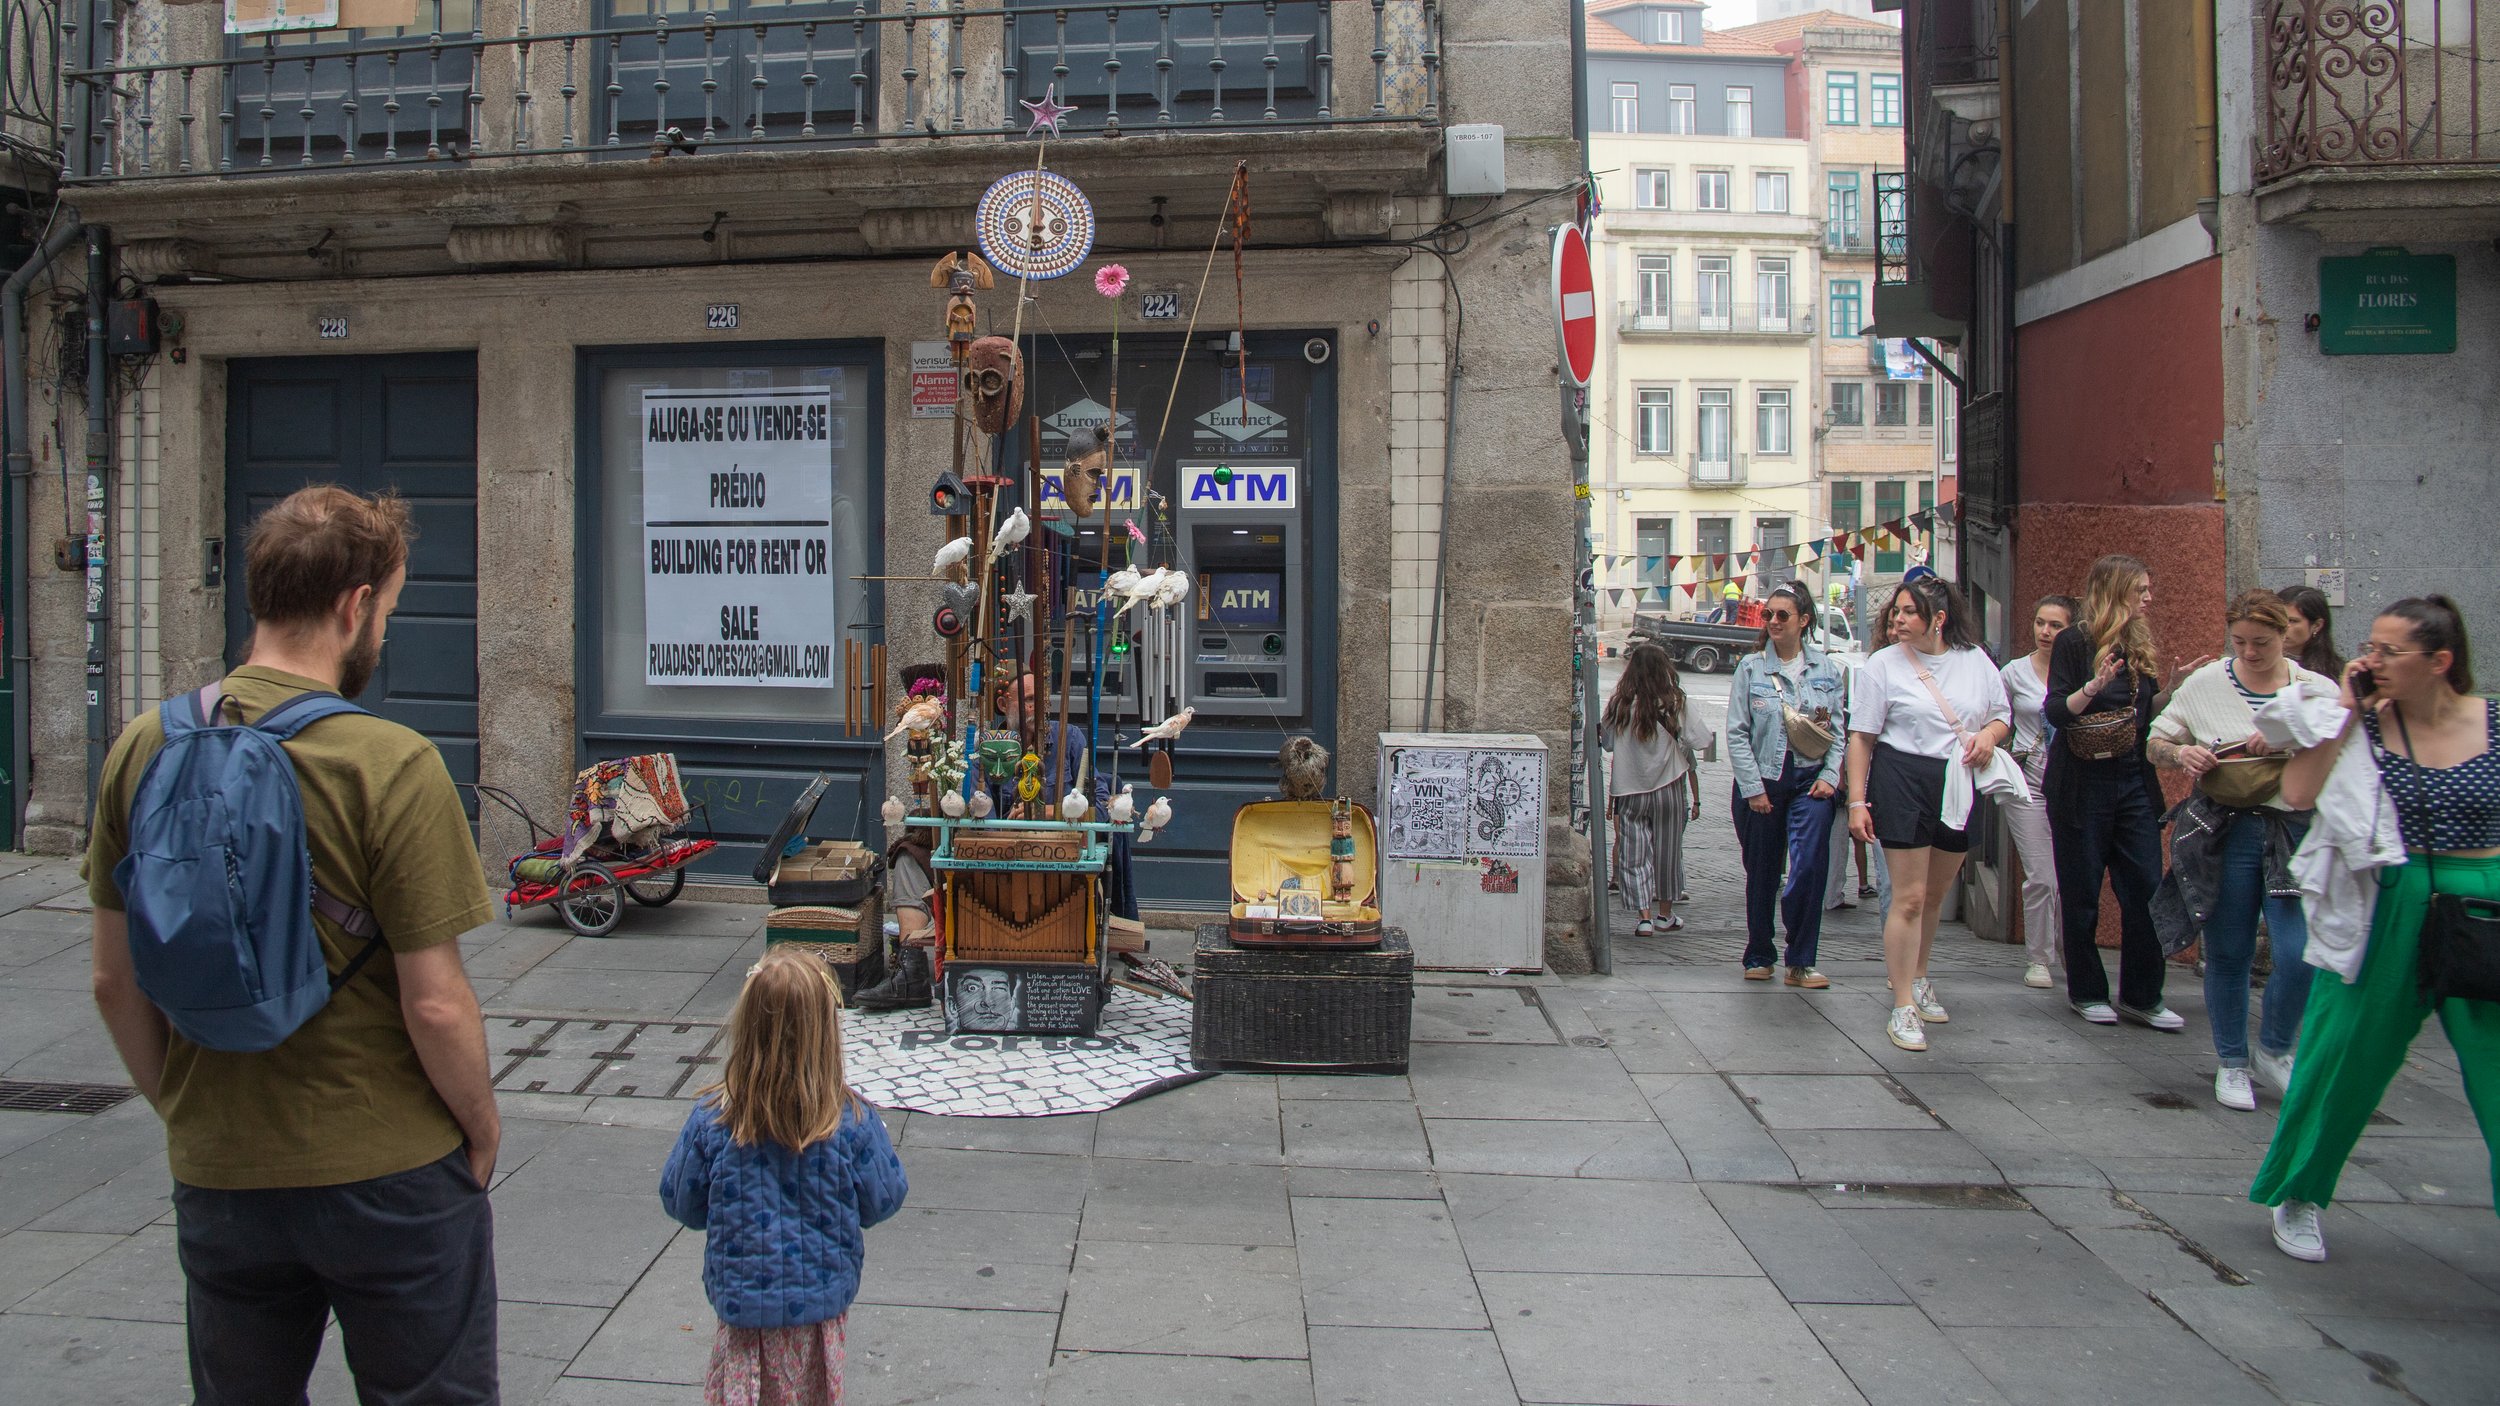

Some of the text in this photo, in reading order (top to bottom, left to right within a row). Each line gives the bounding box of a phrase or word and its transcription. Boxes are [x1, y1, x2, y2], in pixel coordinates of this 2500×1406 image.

[1454, 133, 1493, 141] YBR05-107
[2366, 274, 2409, 285] RUA DAS
[1144, 294, 1176, 317] 224
[2358, 293, 2417, 308] FLORES
[708, 306, 737, 327] 226
[321, 318, 347, 337] 228
[915, 374, 956, 385] Alarme
[649, 404, 827, 443] ALUGA-SE OU VENDE-SE
[710, 463, 766, 508] PRÉDIO
[1040, 475, 1132, 502] AM
[1190, 473, 1287, 502] ATM
[651, 539, 827, 575] BUILDING FOR RENT OR
[1221, 589, 1270, 609] ATM
[720, 605, 760, 641] SALE
[649, 643, 830, 682] RUADASFLORES228@GMAIL.COM
[1414, 784, 1443, 797] WIN
[1052, 973, 1065, 982] your
[1062, 993, 1077, 1001] focus
[1071, 986, 1092, 994] LOVE
[1027, 1008, 1047, 1016] nothing
